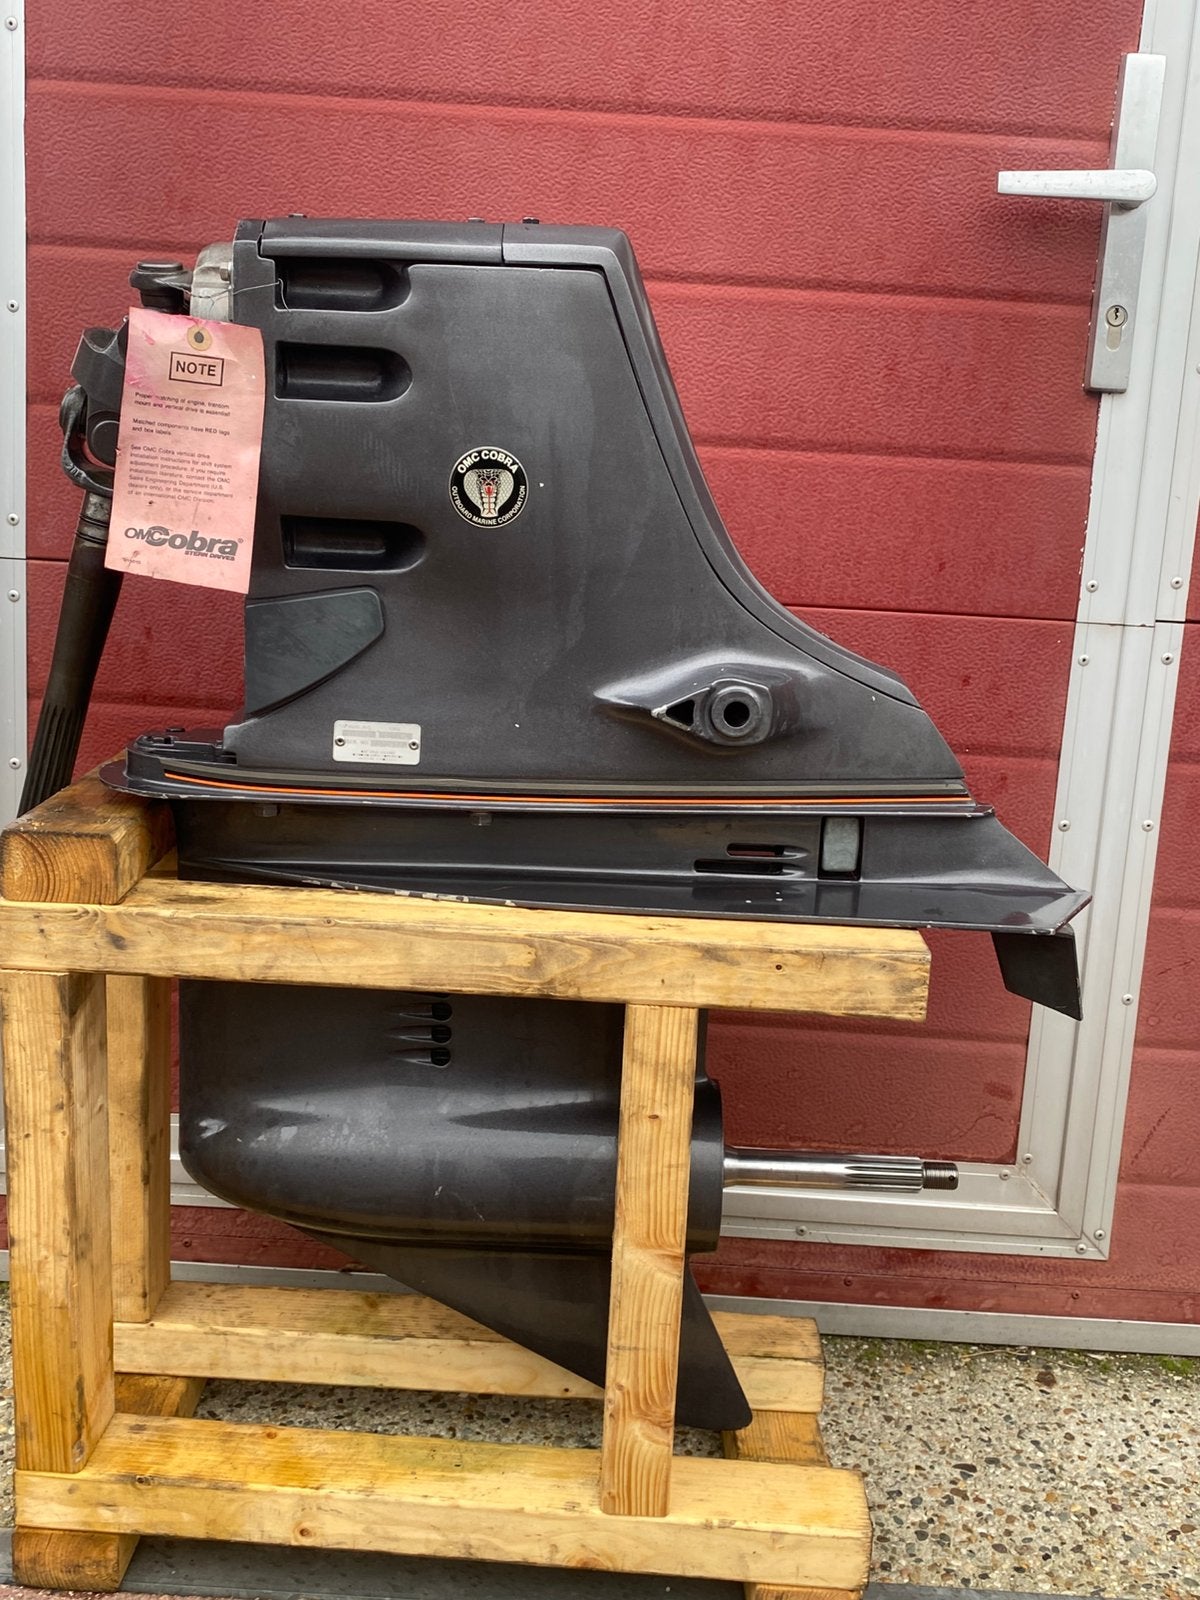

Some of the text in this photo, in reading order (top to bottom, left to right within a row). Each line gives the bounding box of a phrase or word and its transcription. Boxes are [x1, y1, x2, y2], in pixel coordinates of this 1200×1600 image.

[176, 361, 216, 376] NOTE
[457, 450, 519, 474] OMC COBRA
[452, 486, 525, 524] OUTBOARD MARINE CORPORATION
[145, 526, 238, 556] Cobra
[209, 553, 235, 561] DRIVES
